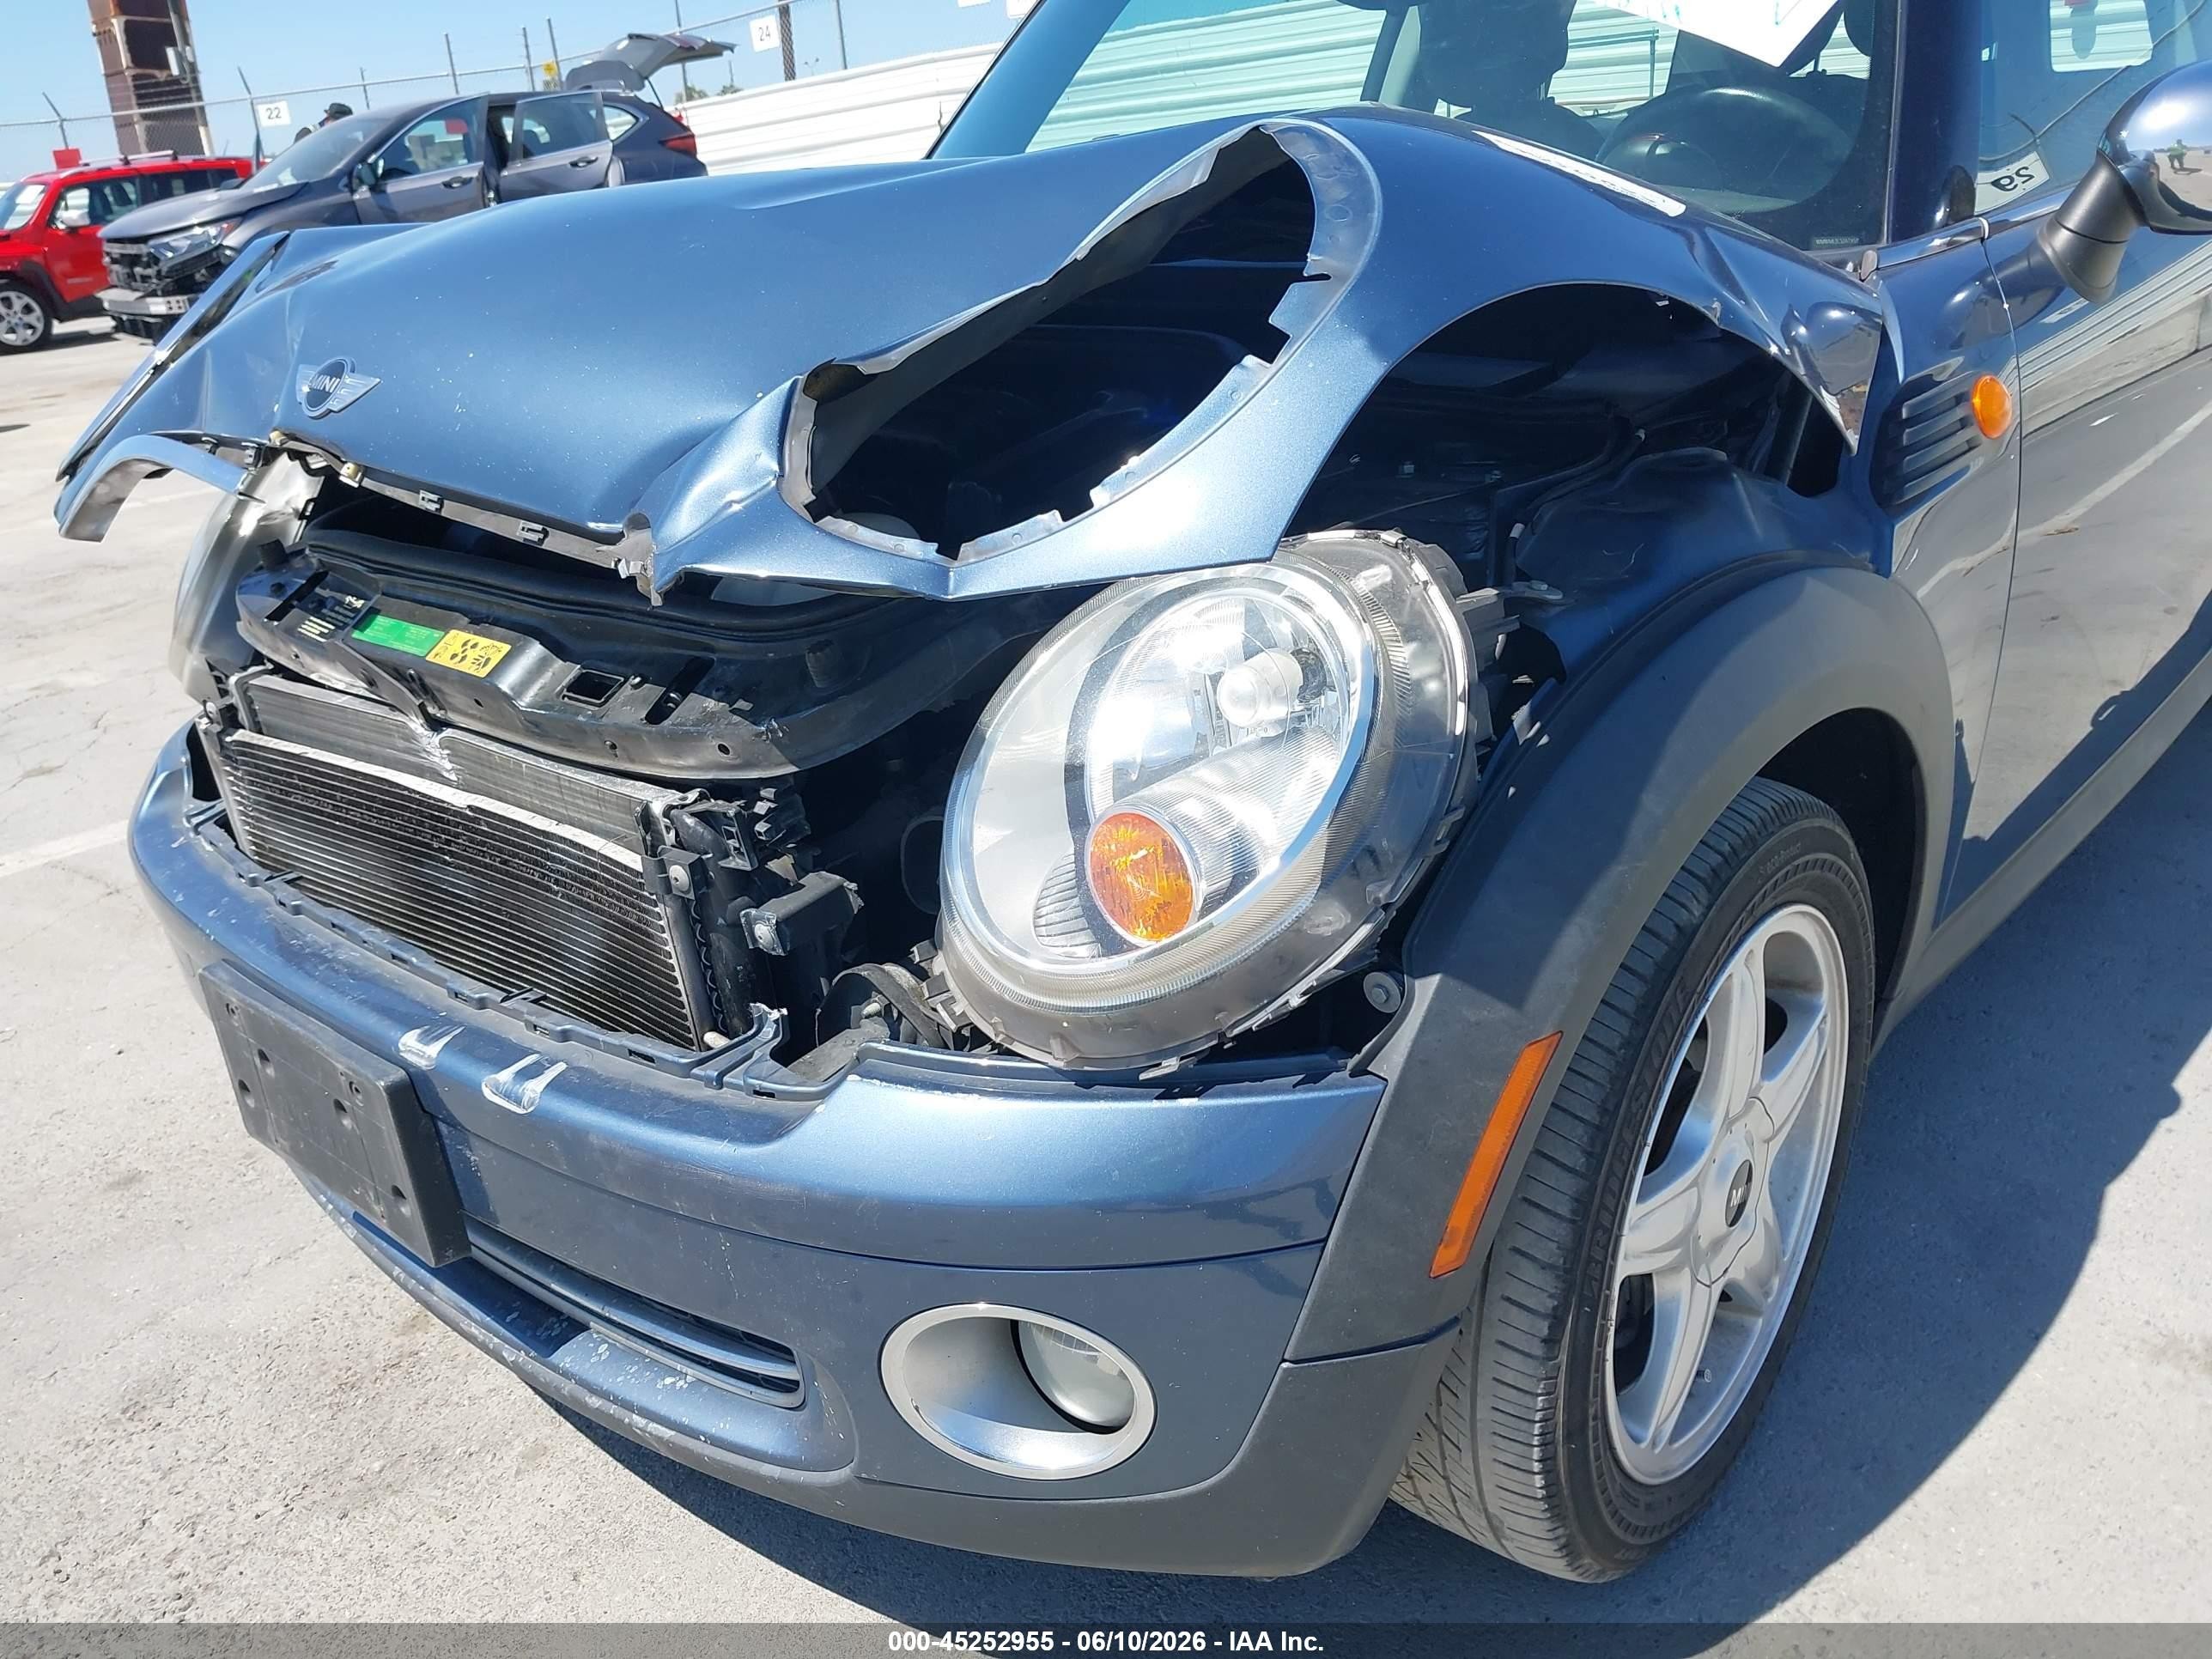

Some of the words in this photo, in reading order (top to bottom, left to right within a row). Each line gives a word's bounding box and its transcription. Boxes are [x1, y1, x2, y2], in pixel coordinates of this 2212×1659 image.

[758, 25, 771, 42] 24
[265, 106, 282, 120] 22
[309, 374, 341, 393] MINI
[1583, 976, 1691, 1298] BRIDGESTONE
